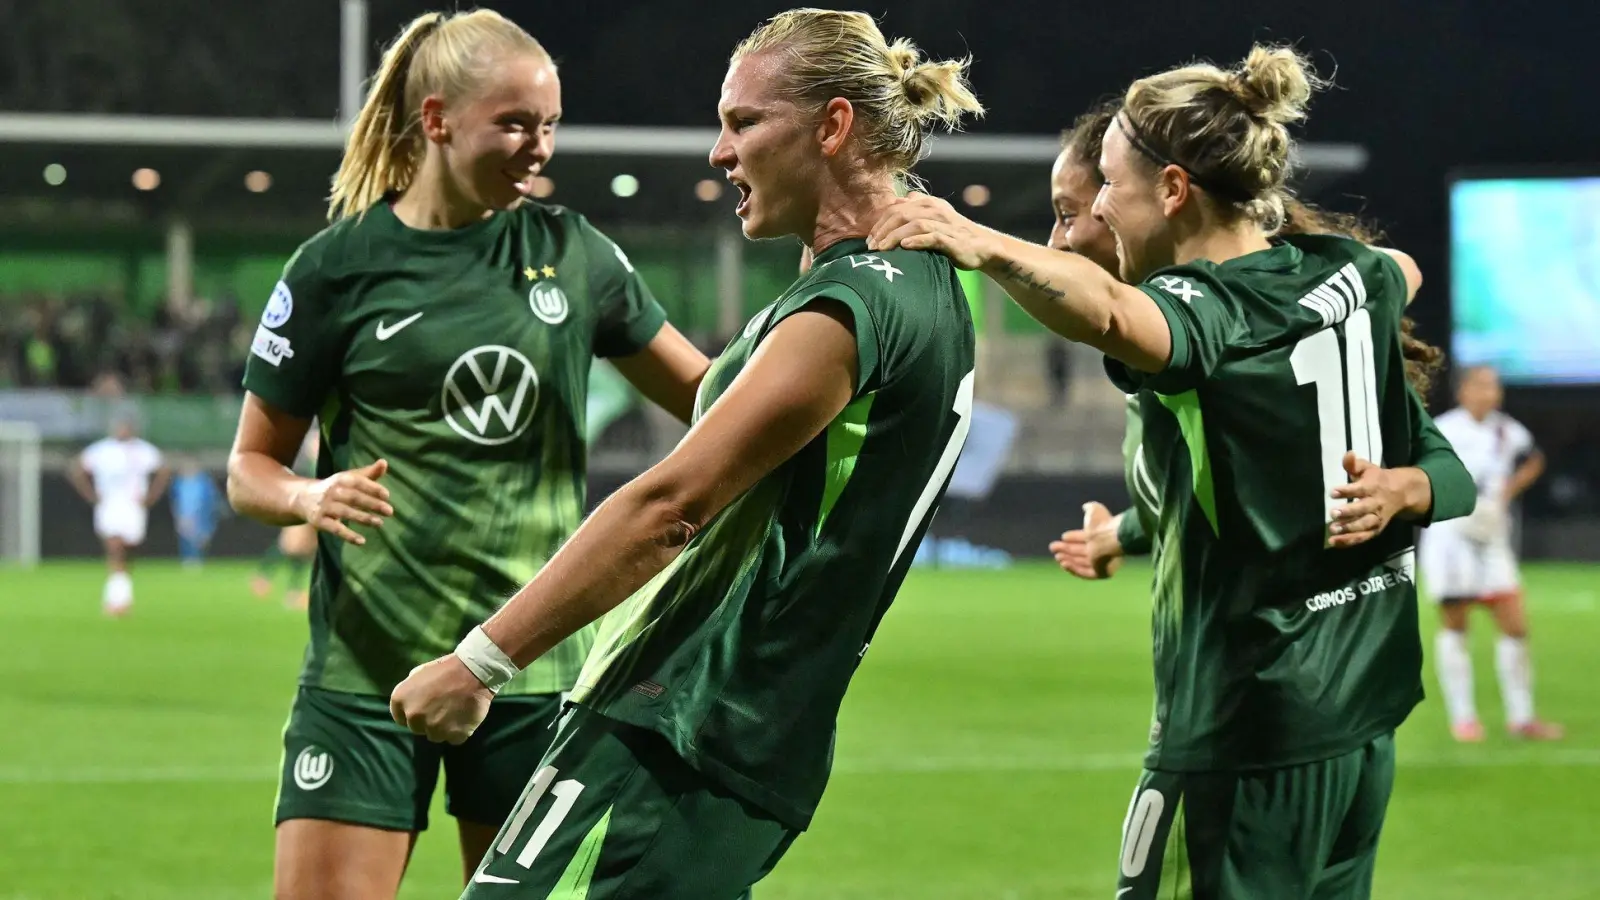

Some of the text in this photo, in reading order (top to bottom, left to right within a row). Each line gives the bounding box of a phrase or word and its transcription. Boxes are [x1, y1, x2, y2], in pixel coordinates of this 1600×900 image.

[442, 345, 539, 445] VW
[1289, 308, 1383, 549] 10
[496, 765, 586, 870] 11
